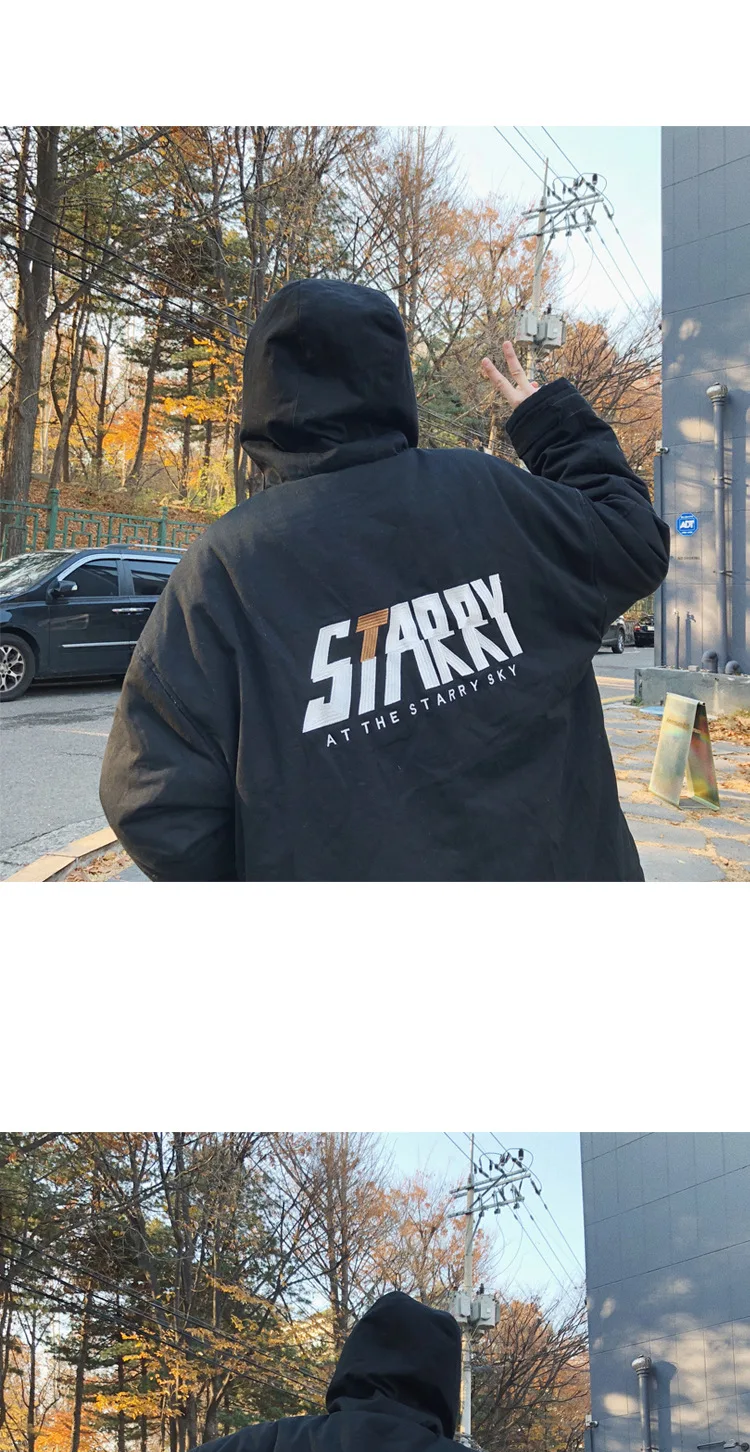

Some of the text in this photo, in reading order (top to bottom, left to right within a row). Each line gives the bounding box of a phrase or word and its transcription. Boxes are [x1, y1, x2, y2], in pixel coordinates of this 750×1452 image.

[680, 520, 695, 529] ADT
[302, 573, 523, 734] STARRY
[326, 664, 517, 748] AT THE STARRY SKY
